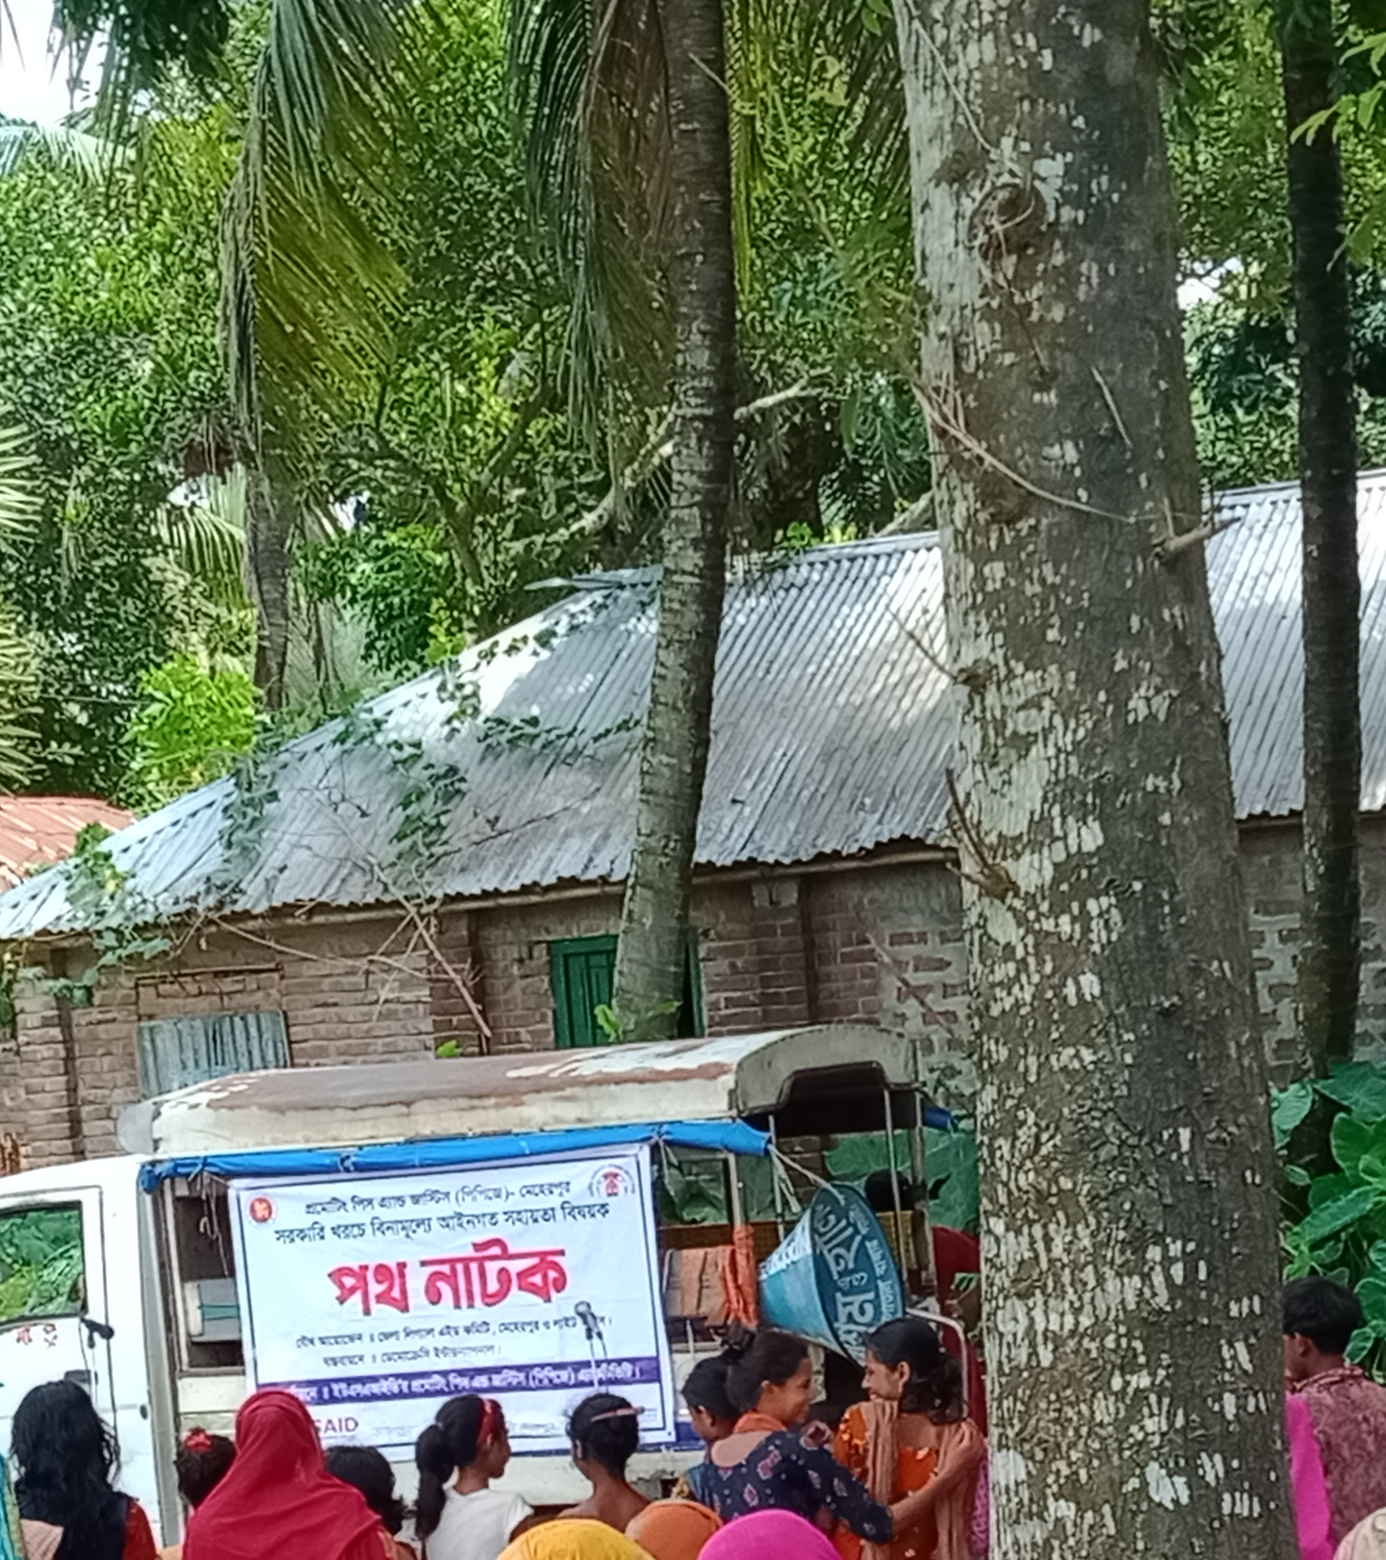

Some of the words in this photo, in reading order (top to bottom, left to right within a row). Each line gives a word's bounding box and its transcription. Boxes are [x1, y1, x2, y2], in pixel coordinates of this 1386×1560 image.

[519, 1181, 571, 1198] মেহেরপুর
[274, 1221, 326, 1244] সরকারি
[330, 1223, 366, 1239] খরচে
[370, 1216, 432, 1240] বিনামূল্যে
[436, 1210, 499, 1231] আইনগত
[502, 1206, 556, 1226] সহায়তা
[560, 1201, 610, 1222] বিষয়ক
[328, 1260, 410, 1317] পথ
[420, 1237, 568, 1310] নাটক
[498, 1320, 539, 1334] মেহেরপুর
